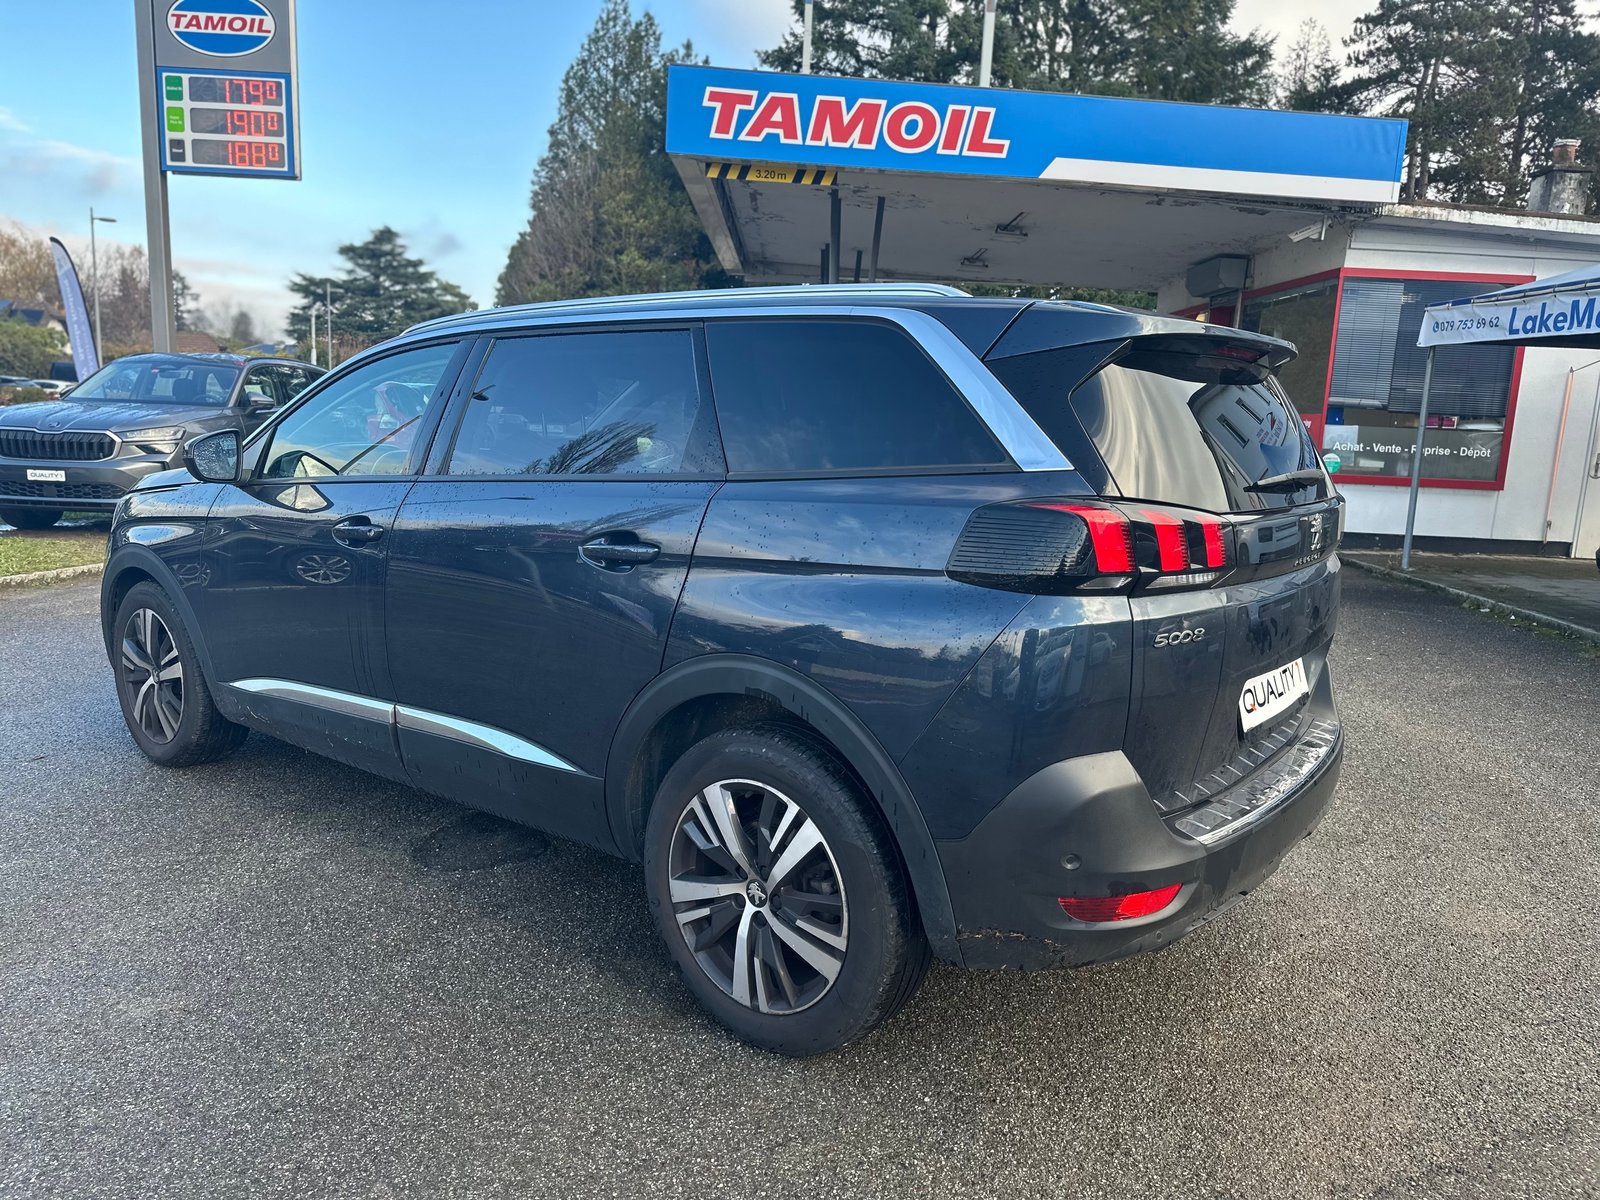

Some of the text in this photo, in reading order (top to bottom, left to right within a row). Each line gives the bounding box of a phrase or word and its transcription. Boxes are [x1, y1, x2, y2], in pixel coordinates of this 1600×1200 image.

[171, 13, 272, 34] TAMOIL
[702, 86, 1010, 158] TAMOIL
[755, 169, 787, 180] 3.20 m
[1440, 320, 1455, 332] 079
[1457, 319, 1475, 330] 753
[1476, 317, 1487, 329] 69
[1488, 316, 1500, 328] 62
[1333, 442, 1363, 452] Achat
[1373, 443, 1401, 453] Vente
[1460, 446, 1491, 459] Dépôt
[1153, 627, 1206, 648] 5008
[1242, 661, 1302, 714] QUALITY 1
